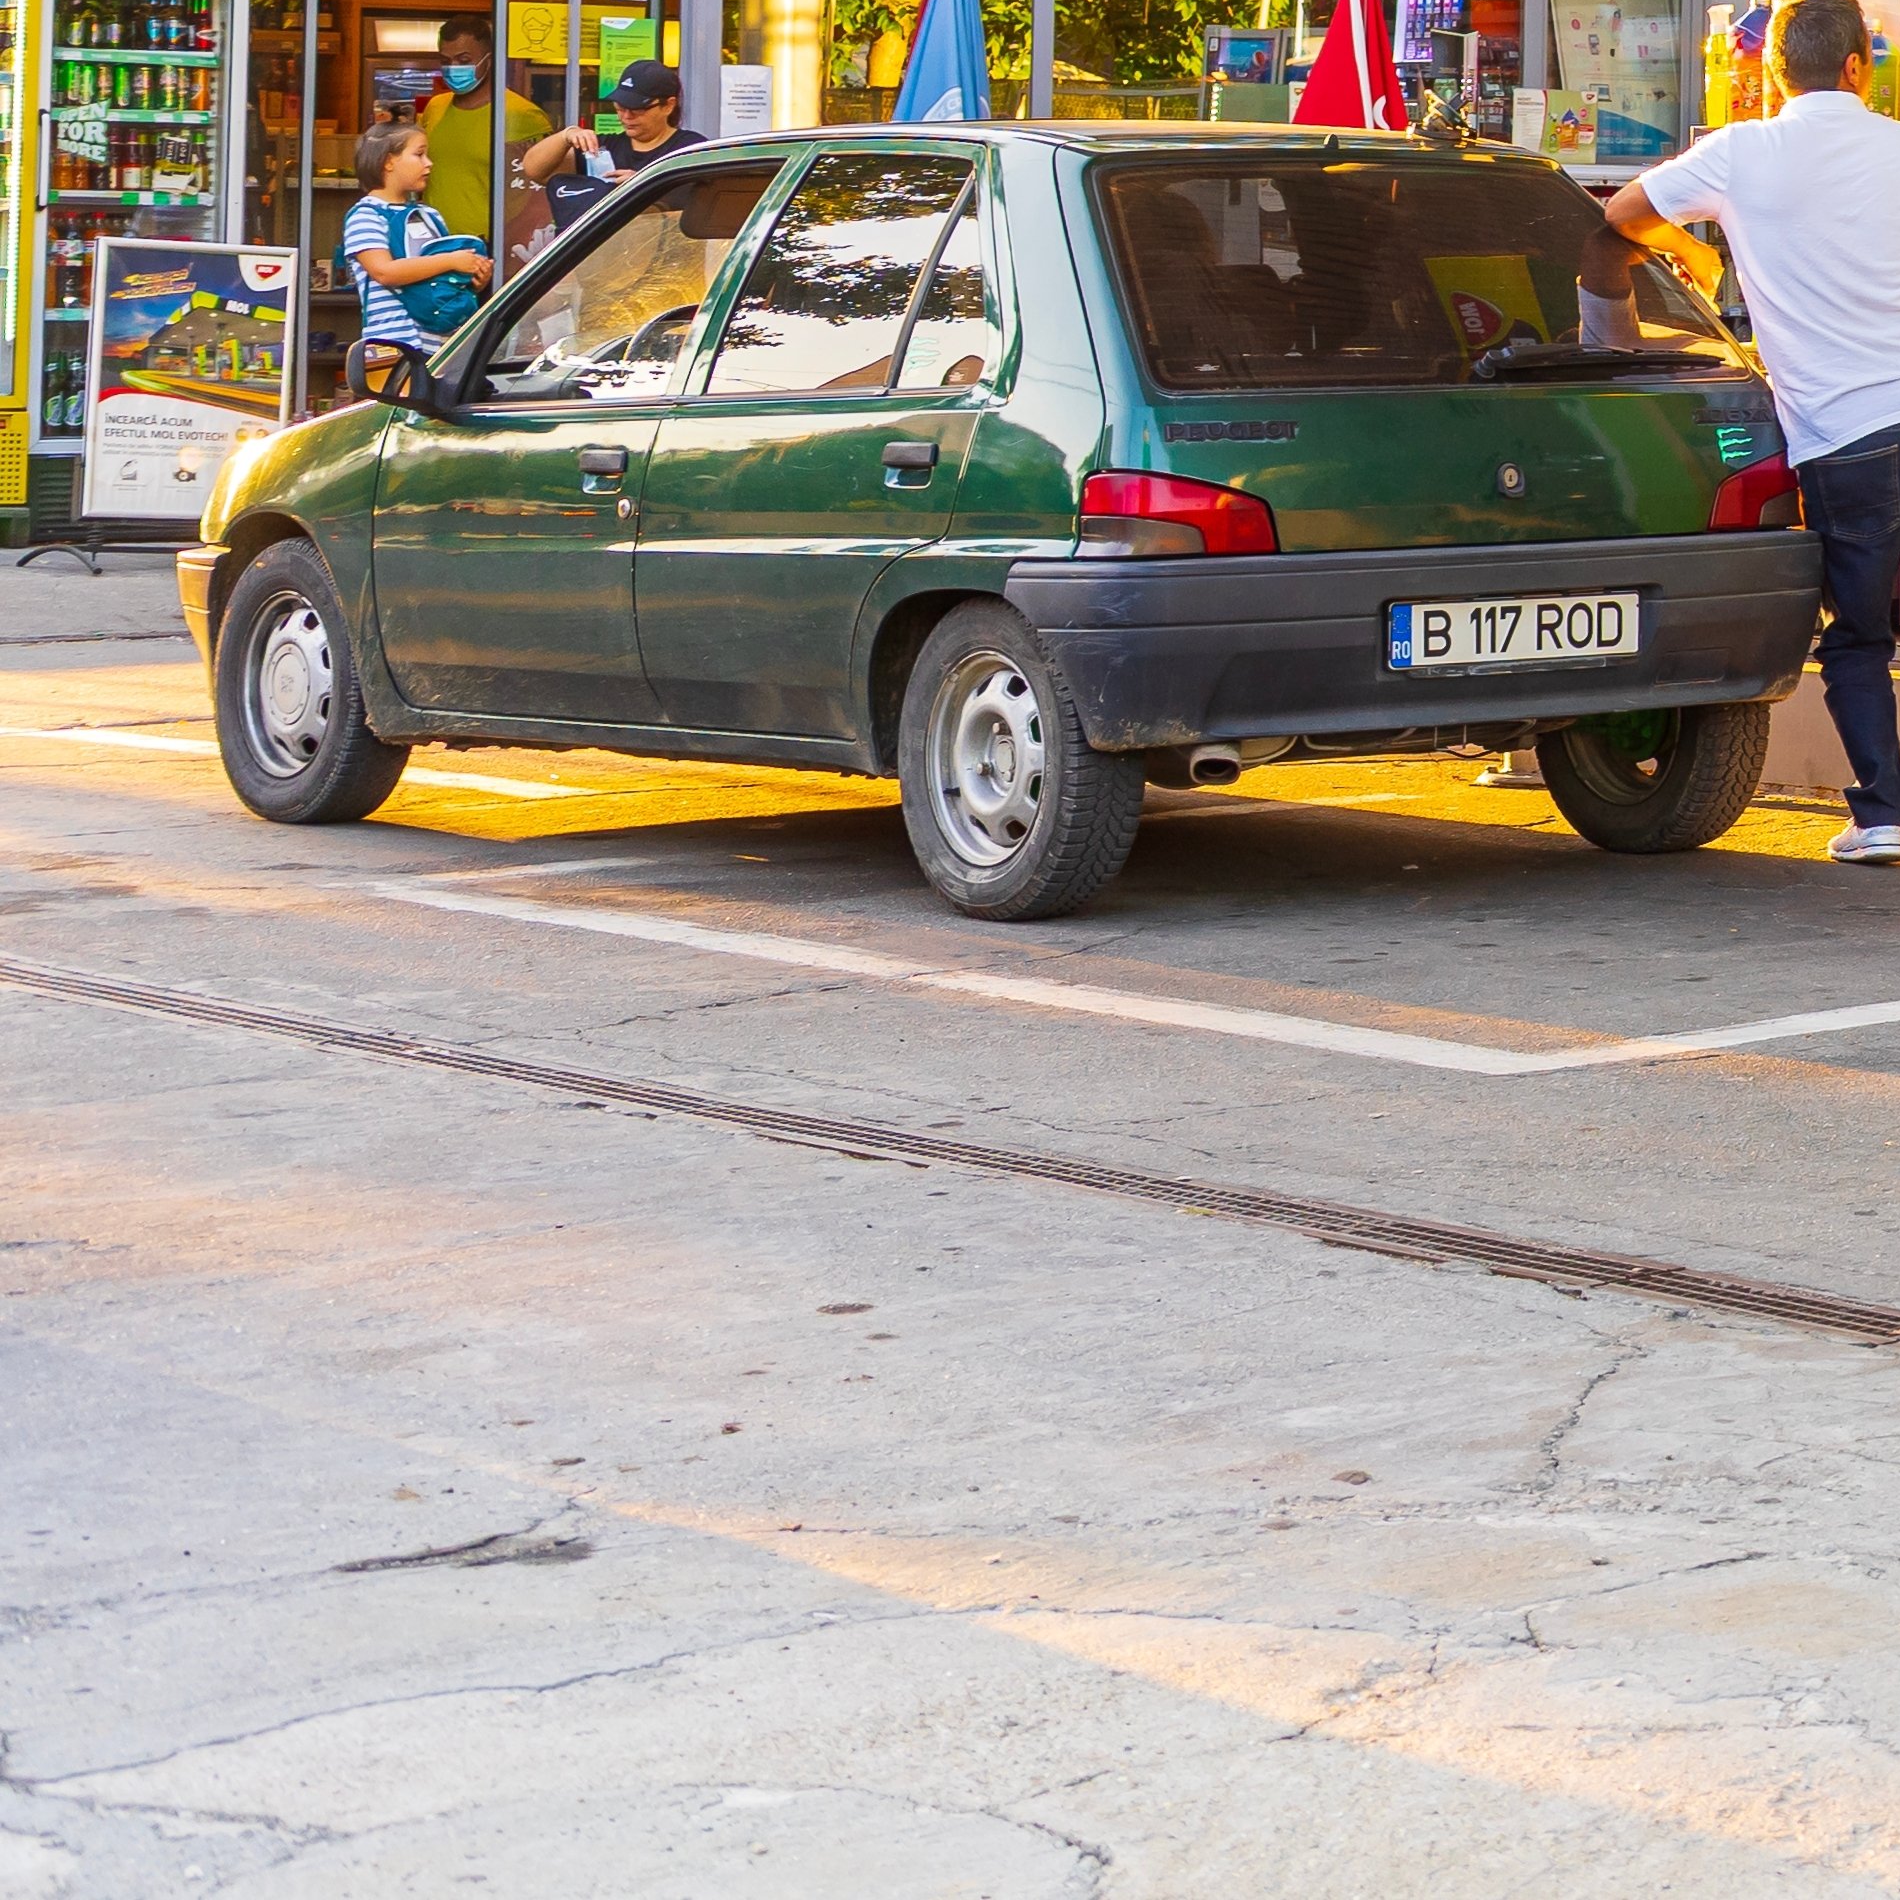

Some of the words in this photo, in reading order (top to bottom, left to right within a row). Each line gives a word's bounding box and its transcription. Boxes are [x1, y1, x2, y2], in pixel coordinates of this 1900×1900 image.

[57, 121, 108, 143] FOR
[104, 412, 158, 426] ÎNCEARCĂ
[160, 417, 193, 427] ACUM
[104, 427, 147, 439] EFECTUL
[150, 430, 176, 440] MOL
[1165, 421, 1298, 442] PEUGEOT
[1392, 641, 1411, 660] RO
[1422, 610, 1452, 658] B
[1470, 605, 1523, 655] 117
[1536, 601, 1623, 651] ROD
